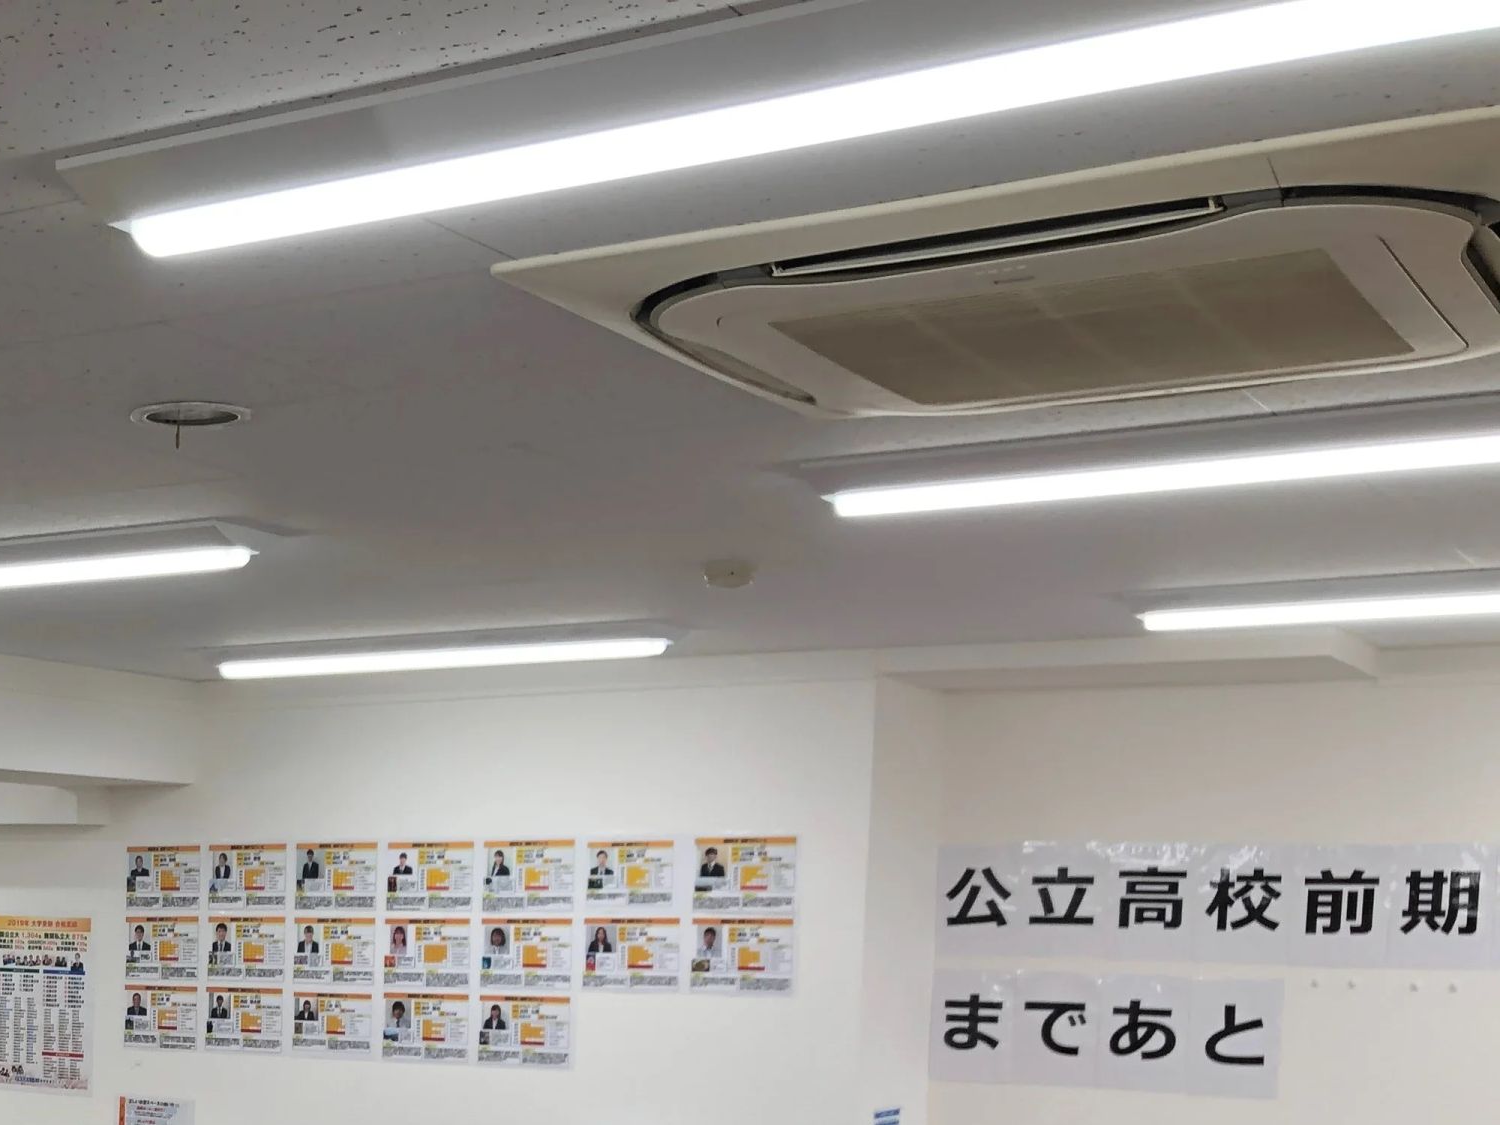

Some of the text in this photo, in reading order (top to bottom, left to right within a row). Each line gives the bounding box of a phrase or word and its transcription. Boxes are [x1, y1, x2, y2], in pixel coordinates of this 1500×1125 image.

[945, 866, 1482, 935] 公立高校前期
[943, 993, 1265, 1065] まであと
